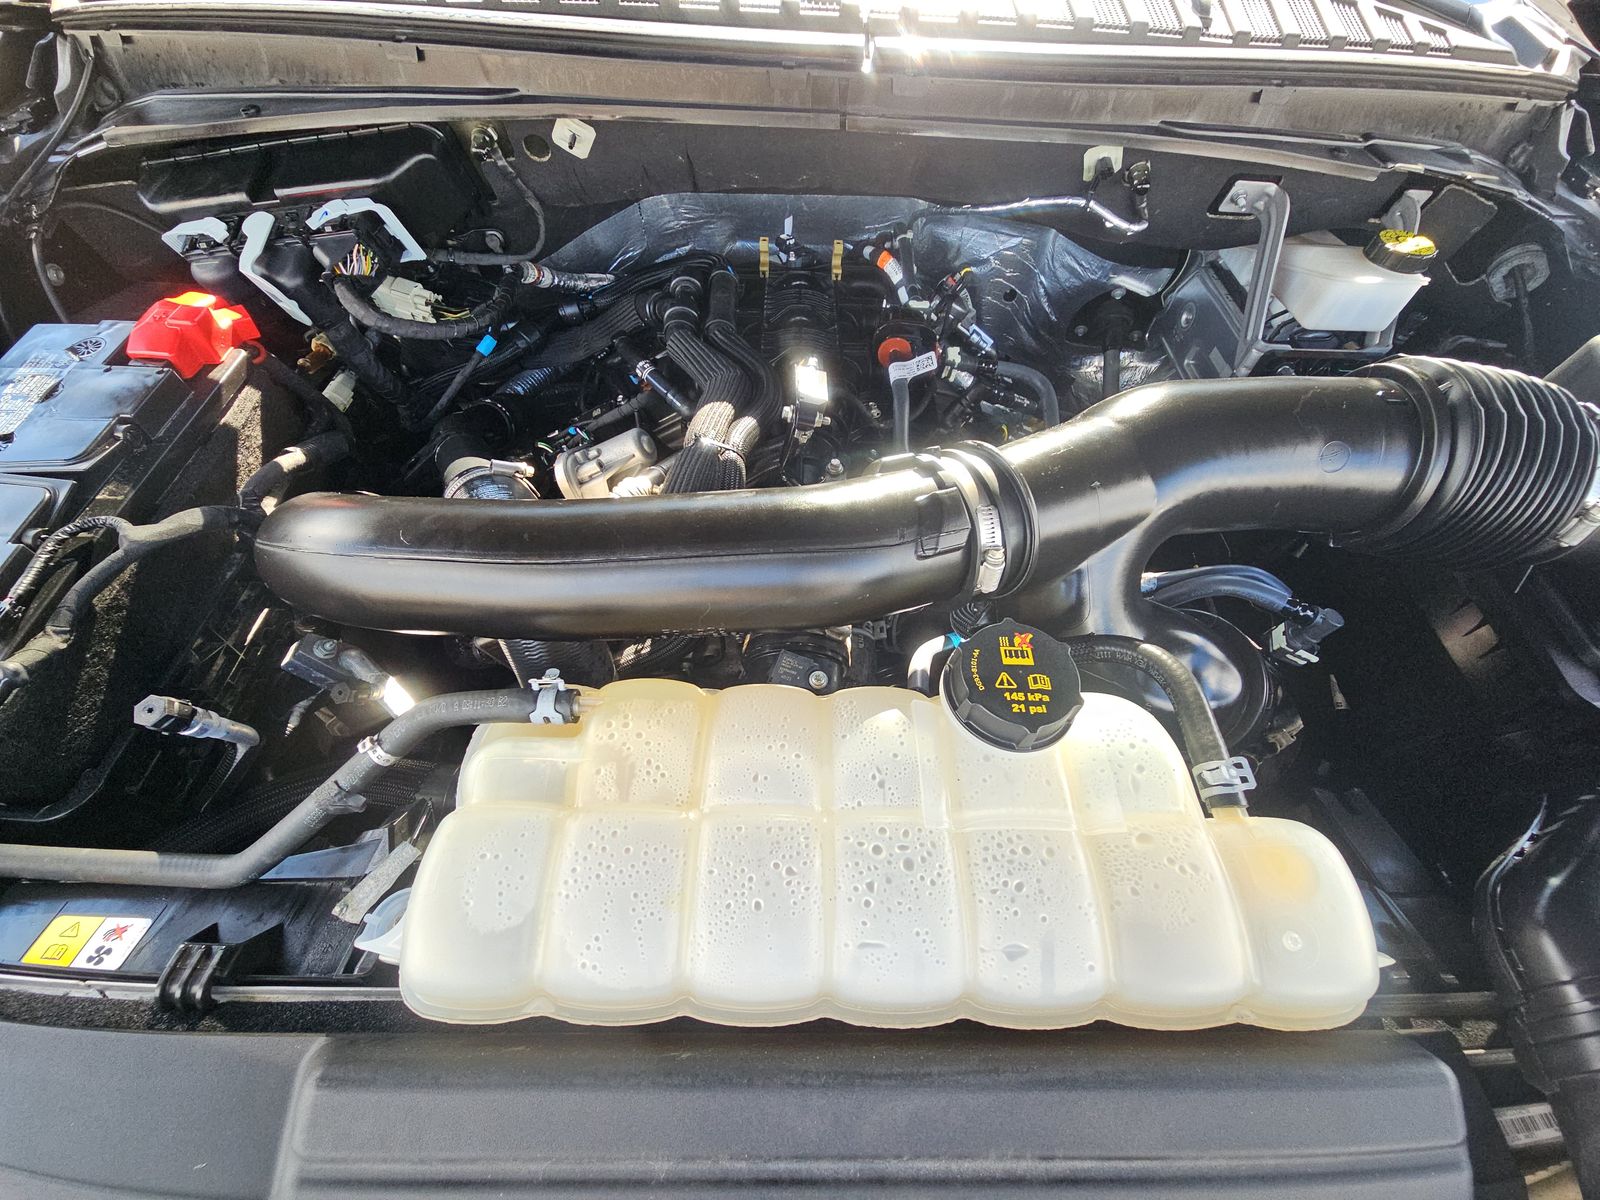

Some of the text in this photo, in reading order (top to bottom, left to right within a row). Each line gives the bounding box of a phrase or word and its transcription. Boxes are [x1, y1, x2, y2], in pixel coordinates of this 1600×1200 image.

[1003, 691, 1050, 702] 145 kPa
[1011, 703, 1048, 715] 21 psi
